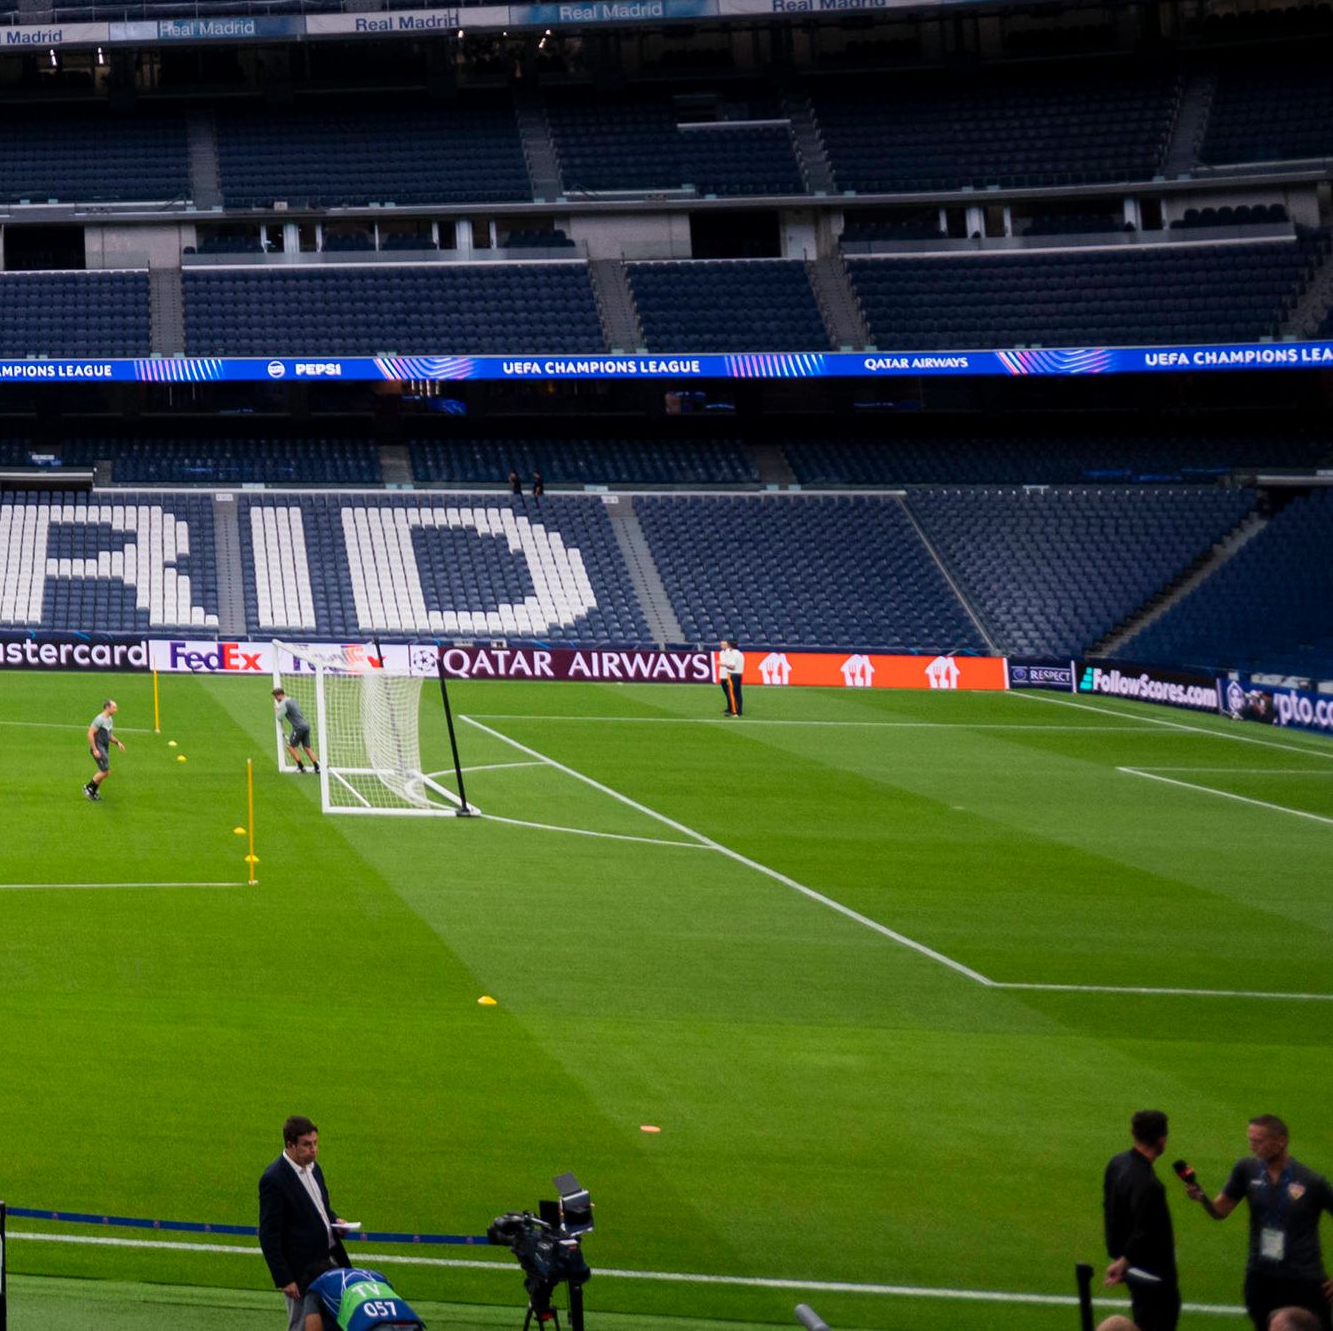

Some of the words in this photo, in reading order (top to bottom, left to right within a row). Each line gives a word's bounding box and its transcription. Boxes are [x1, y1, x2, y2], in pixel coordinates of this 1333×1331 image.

[559, 5, 597, 21] Real
[601, 3, 663, 18] Madrid
[160, 23, 194, 37] Real
[199, 21, 255, 35] Madrid
[356, 17, 392, 31] Real
[398, 14, 460, 30] Madrid
[5, 30, 63, 44] Madrid
[864, 358, 910, 370] QATAR
[912, 357, 968, 369] AIRWAYS
[1145, 352, 1189, 366] UEFA
[1193, 349, 1297, 365] CHAMPIONS
[1302, 348, 1333, 362] LEA
[58, 365, 112, 376] LEAGUE
[295, 363, 341, 375] PEPSI
[503, 362, 541, 374] UEFA
[545, 362, 635, 373] CHAMPIONS
[640, 361, 700, 373] LEAGUE
[170, 642, 263, 671] FedEx
[443, 651, 554, 677] QATAR
[568, 653, 711, 679] AIRWAYS
[1030, 669, 1071, 681] RESPECT
[1093, 668, 1216, 708] FollowScores.com
[351, 1283, 381, 1298] TV
[363, 1301, 397, 1317] 057
